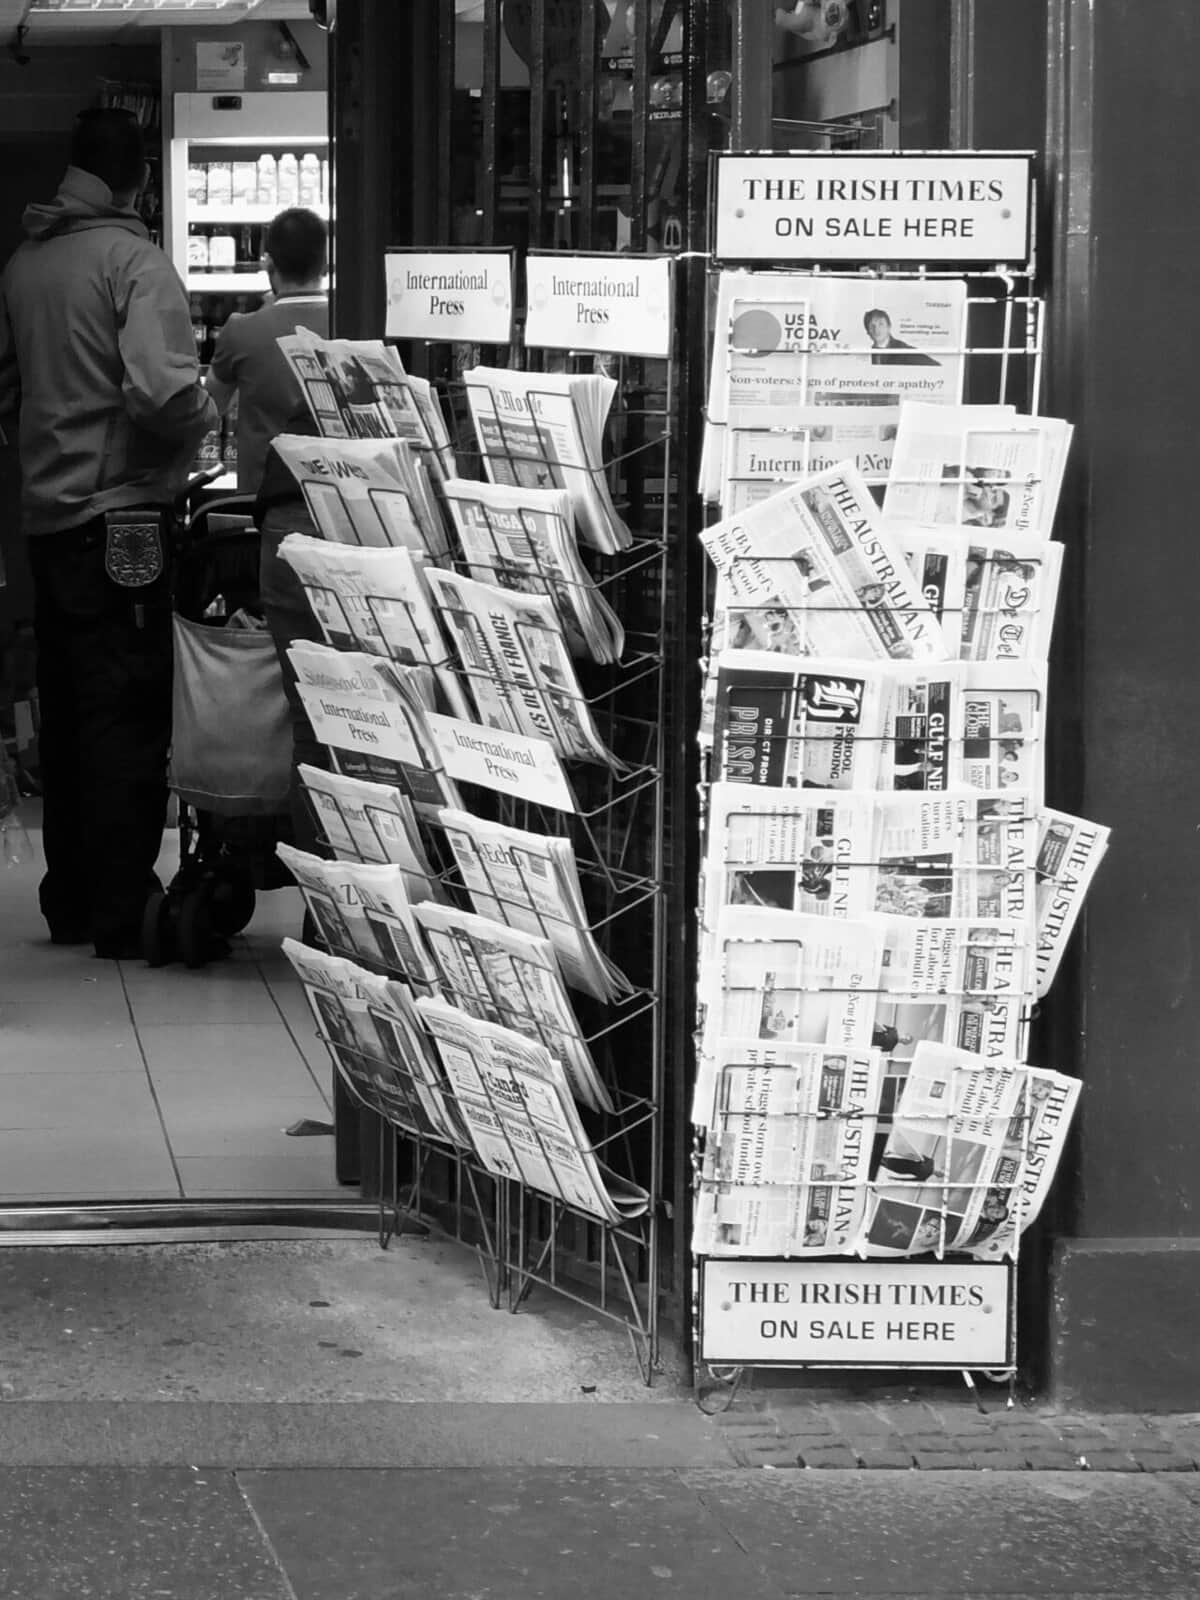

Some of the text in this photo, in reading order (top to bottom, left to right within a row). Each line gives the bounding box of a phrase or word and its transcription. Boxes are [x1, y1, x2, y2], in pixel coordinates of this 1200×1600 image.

[743, 180, 1003, 201] THE IRISH TIMES
[776, 218, 973, 237] ON SALE HERE
[406, 269, 488, 291] International
[552, 275, 640, 298] International
[429, 295, 465, 315] Press
[576, 302, 609, 324] Press
[785, 314, 817, 326] USA
[796, 377, 816, 388] Sgn
[820, 378, 836, 387] of
[839, 378, 880, 389] protest
[883, 380, 894, 388] or
[898, 379, 944, 390] apathy?
[717, 532, 734, 554] bid
[731, 526, 754, 554] CBA
[828, 477, 861, 517] THE
[850, 517, 928, 640] AUSTRALIAN
[320, 699, 391, 727] International
[978, 703, 990, 728] THE
[348, 723, 379, 743] Press
[452, 729, 536, 768] International
[759, 718, 772, 783] DIRCT FROM
[842, 726, 855, 774] SCHOOL
[929, 713, 944, 760] GULF
[484, 757, 520, 783] Press
[830, 726, 843, 779] FUNDING
[921, 803, 930, 849] Coalition
[933, 826, 940, 839] on
[1007, 797, 1024, 841] THE
[1068, 832, 1097, 872] THE
[910, 928, 927, 999] Turnbull ea
[925, 927, 940, 980] for Labor
[941, 927, 955, 968] Biggest
[993, 928, 1015, 979] THE
[839, 994, 861, 1044] New York
[744, 1049, 759, 1091] prvate
[762, 1050, 776, 1074] Lis
[961, 1071, 980, 1114] urnbull
[1041, 1085, 1071, 1127] THE
[753, 1122, 765, 1159] storm
[833, 1059, 870, 1232] THE AUSTRALIAN
[729, 1282, 984, 1307] THE IRISH TIMES
[760, 1320, 956, 1340] ON SALE HERE
